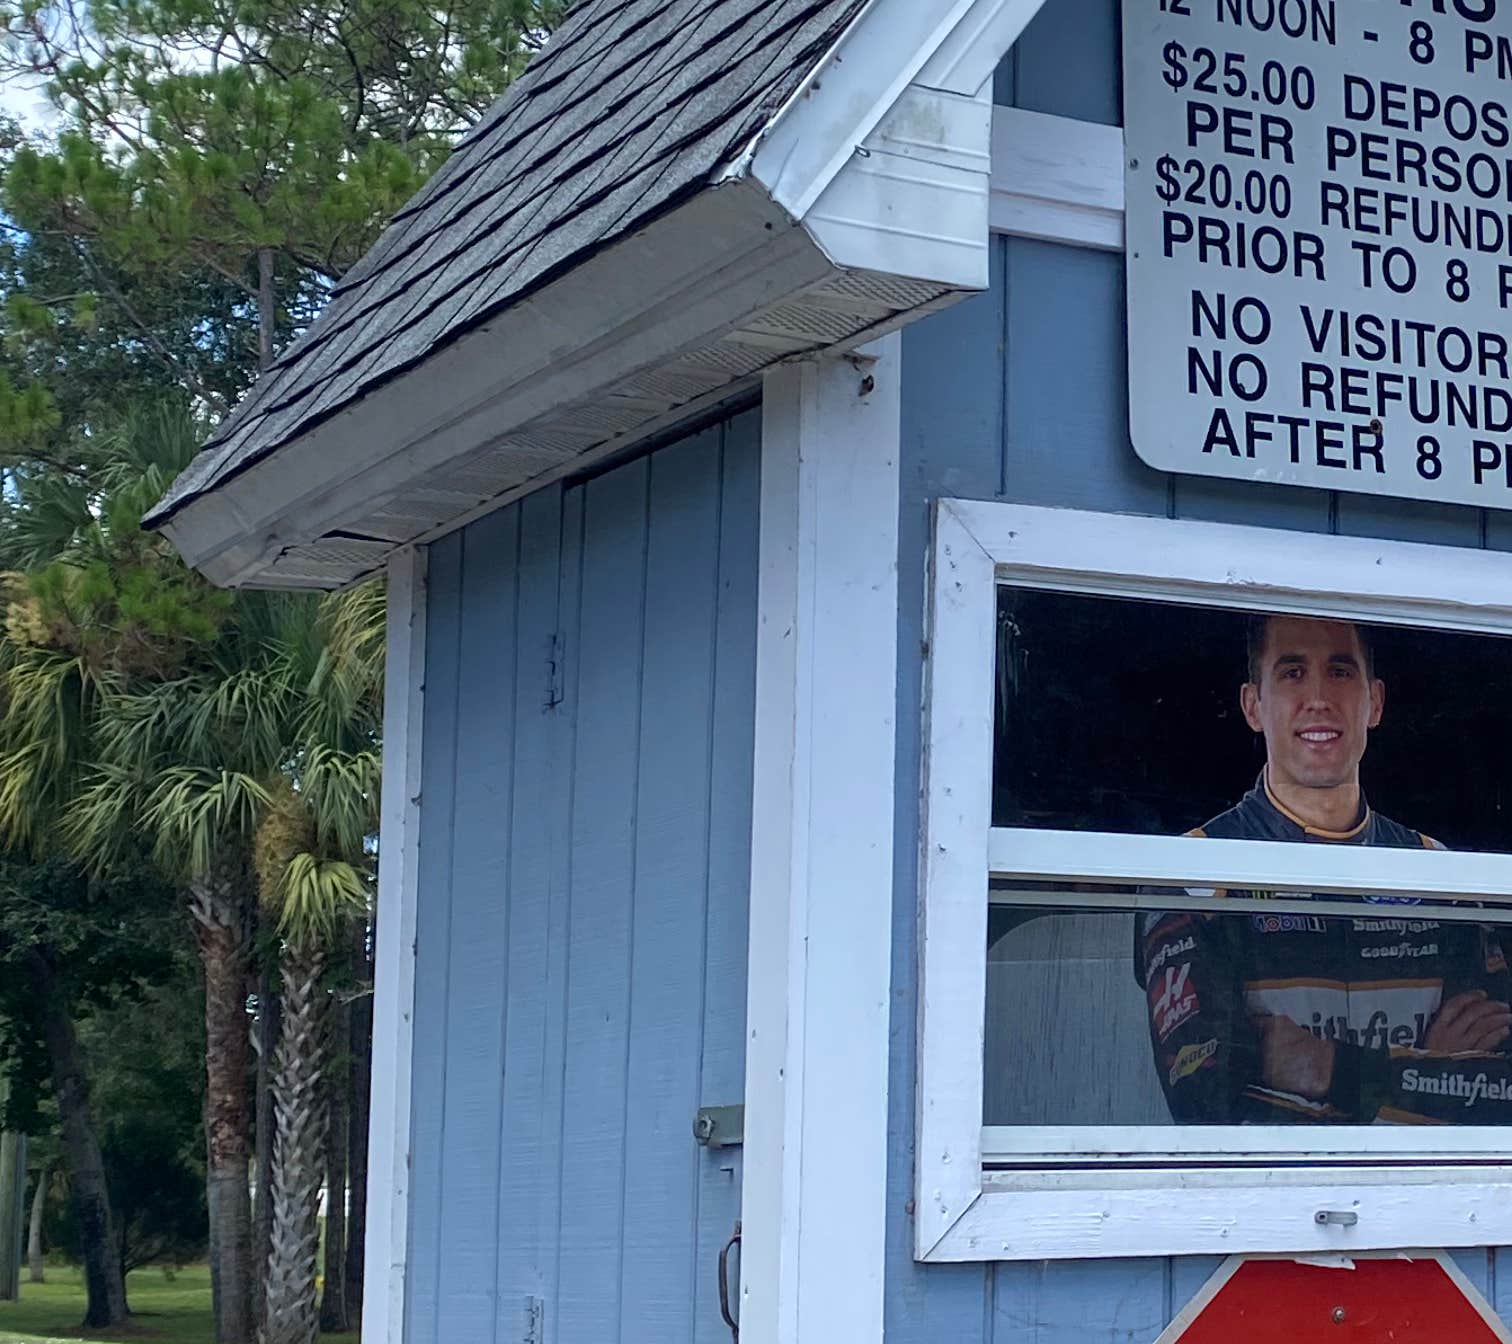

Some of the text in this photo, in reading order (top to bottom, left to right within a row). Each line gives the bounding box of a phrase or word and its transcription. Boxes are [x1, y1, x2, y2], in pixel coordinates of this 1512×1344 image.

[1408, 22, 1435, 65] 8
[1162, 41, 1315, 111] $25.00
[1187, 102, 1295, 164] PER
[1156, 153, 1291, 219] $20.00
[1162, 211, 1326, 282] PRIOR
[1351, 241, 1417, 295] TO
[1446, 259, 1470, 304] 8
[1192, 290, 1271, 344] NO
[1187, 347, 1268, 402] NO
[1202, 408, 1386, 474] AFTER
[1416, 435, 1443, 481] 8
